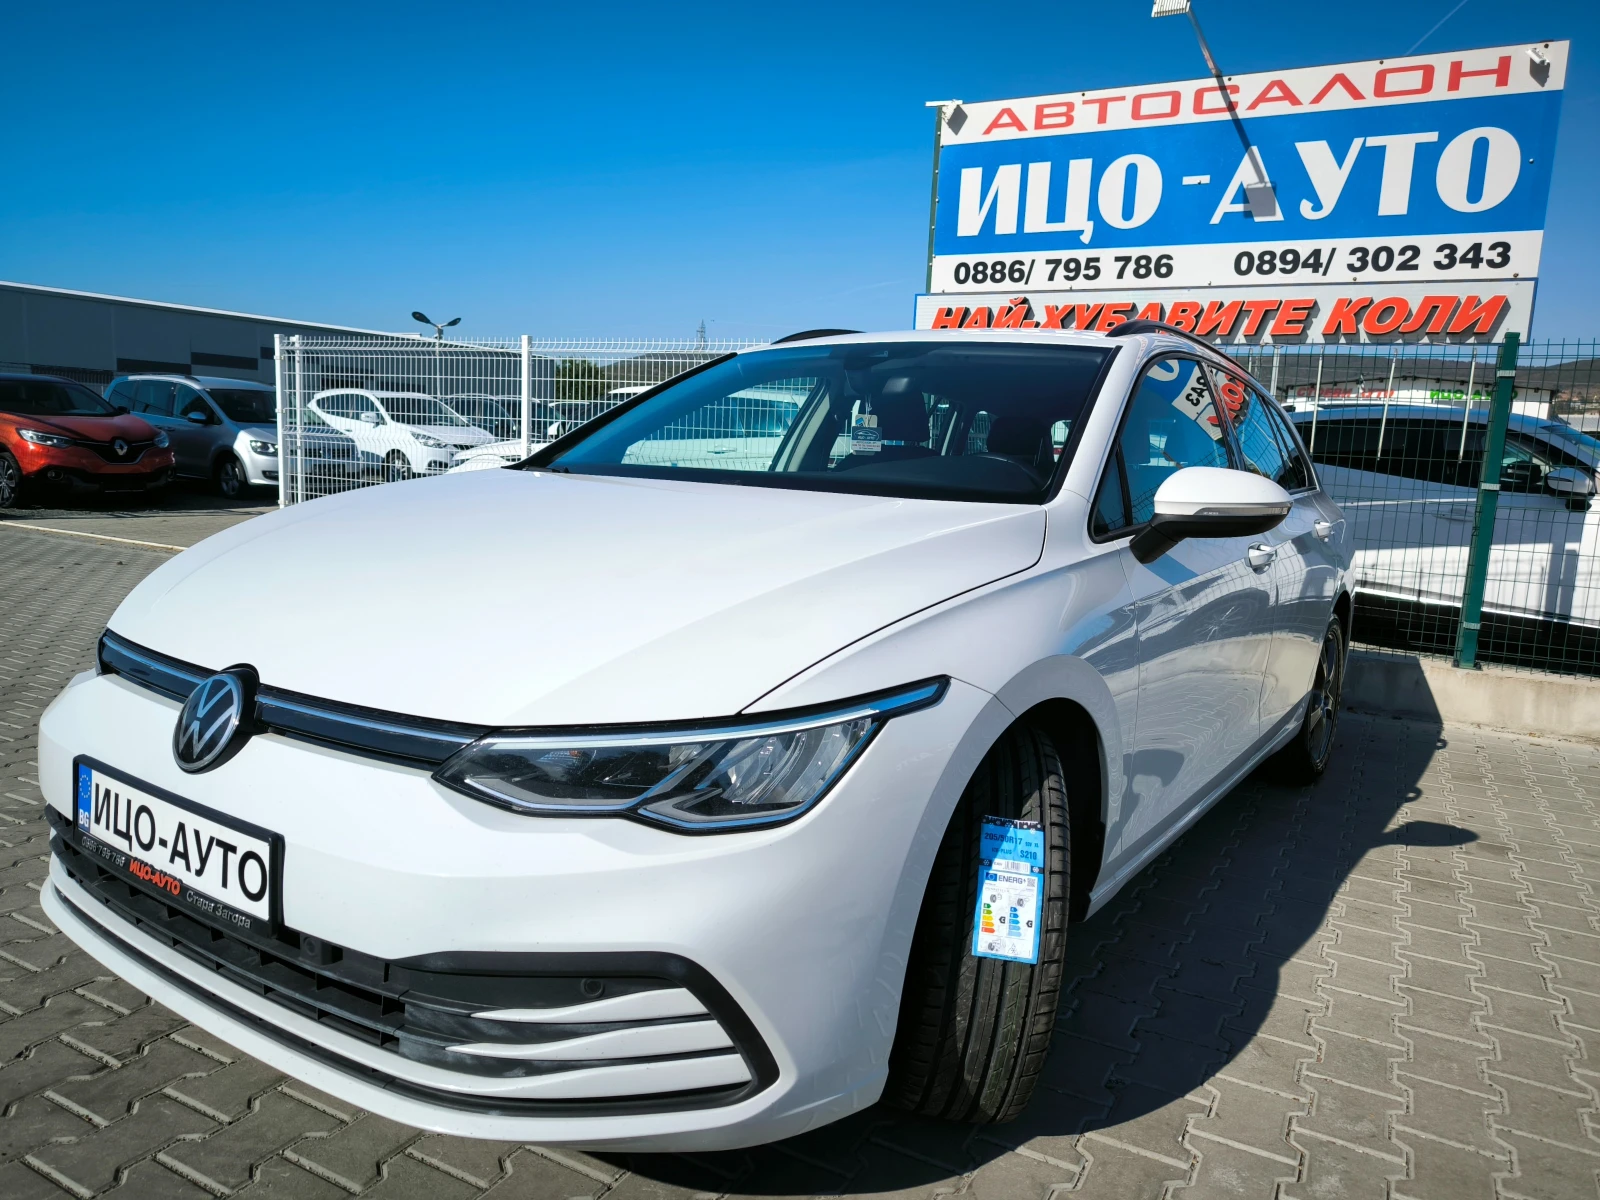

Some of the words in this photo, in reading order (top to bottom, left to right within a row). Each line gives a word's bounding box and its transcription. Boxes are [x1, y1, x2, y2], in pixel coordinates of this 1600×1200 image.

[982, 55, 1512, 135] АВТОСАЛОН
[953, 259, 1036, 286] 0886/
[1045, 256, 1102, 282] 795
[1113, 253, 1174, 280] 786
[1233, 247, 1337, 277] 0894/
[1346, 244, 1421, 273] 302
[1433, 241, 1512, 271] 343
[1322, 294, 1507, 335] КОЛИ
[79, 808, 90, 828] BG
[984, 832, 1023, 845] 205/50R17
[94, 782, 268, 902] ИЦО-АУТО
[1020, 849, 1037, 860] S210
[129, 859, 181, 896] ИЦО-АУТО
[186, 890, 214, 912] Стара
[215, 904, 251, 929] Загора
[998, 875, 1023, 885] ENERG
